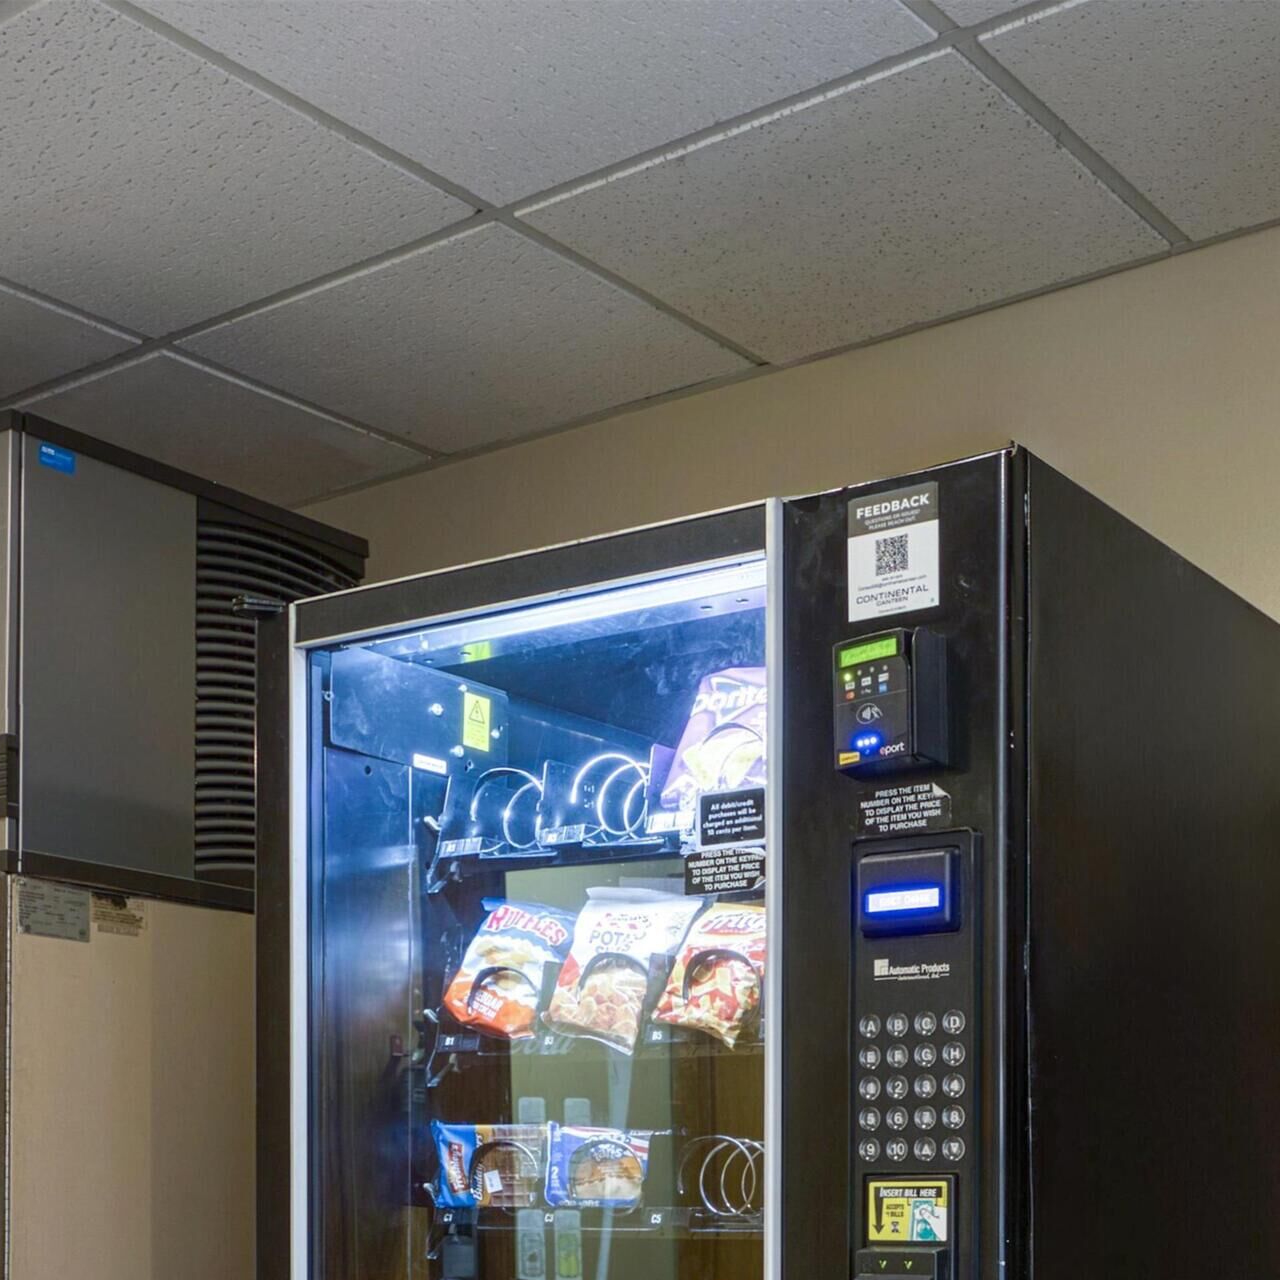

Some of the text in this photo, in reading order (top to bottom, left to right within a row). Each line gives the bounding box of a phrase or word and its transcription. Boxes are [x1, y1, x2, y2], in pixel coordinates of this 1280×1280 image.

[856, 493, 929, 519] FEEDBACK
[856, 584, 929, 605] CONTINENTAL
[876, 596, 909, 606] CANTEEN
[875, 783, 930, 798] PRESS THE ITEM
[860, 799, 890, 809] NUMBER
[902, 795, 916, 803] THE
[876, 805, 904, 815] DISPLAY
[904, 803, 918, 811] THE
[919, 800, 941, 809] PRICE
[708, 811, 736, 821] purchases
[876, 815, 889, 824] THE
[891, 813, 907, 822] ITEM
[908, 811, 922, 819] YOU
[922, 808, 941, 818] WISH
[889, 819, 927, 830] PURCHASE
[687, 859, 715, 869] NUMBER
[726, 856, 738, 864] THE
[701, 866, 727, 875] DISPLAY
[728, 864, 740, 872] THE
[740, 862, 760, 870] PRICE
[702, 875, 714, 883] THE
[714, 873, 730, 882] ITEM
[730, 872, 743, 880] YOU
[743, 870, 760, 878] WISH
[714, 879, 748, 890] PURCHASE
[889, 963, 950, 975] Automatic Products
[866, 1016, 960, 1032] A B C D
[894, 1050, 902, 1062] F
[921, 1048, 932, 1061] G
[950, 1047, 960, 1060] H
[894, 1081, 903, 1093] 2
[922, 1080, 931, 1092] 3
[950, 1079, 960, 1091] 4
[867, 1112, 876, 1125] 5
[894, 1112, 903, 1124] 6
[950, 1110, 960, 1123] 8
[866, 1143, 905, 1156] 9 10
[551, 1166, 558, 1179] 2
[879, 1187, 937, 1198] INSERT BILL HERE
[443, 1213, 453, 1222] C1
[544, 1213, 554, 1222] C3
[650, 1214, 662, 1224] C5
